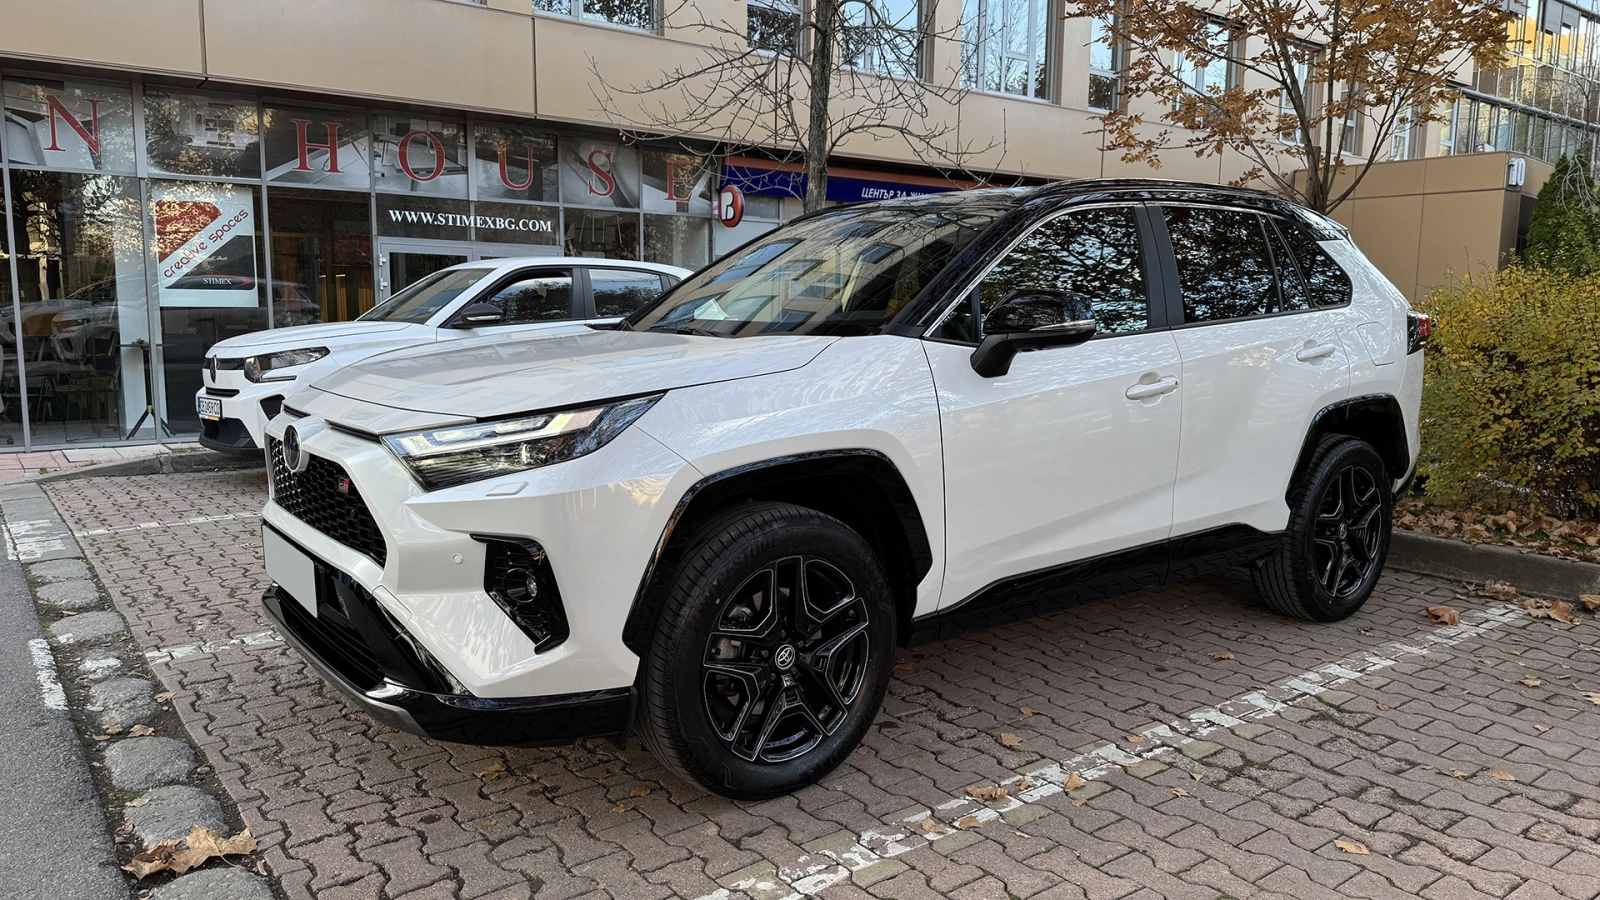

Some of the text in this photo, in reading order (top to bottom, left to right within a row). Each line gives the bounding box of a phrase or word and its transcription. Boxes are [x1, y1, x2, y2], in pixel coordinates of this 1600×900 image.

[1508, 158, 1525, 186] 10
[861, 187, 895, 200] ЦЕНТЪР
[388, 208, 553, 233] WWW.STIMEXBG.COM
[164, 210, 249, 278] creative spaces
[338, 481, 348, 493] GR
